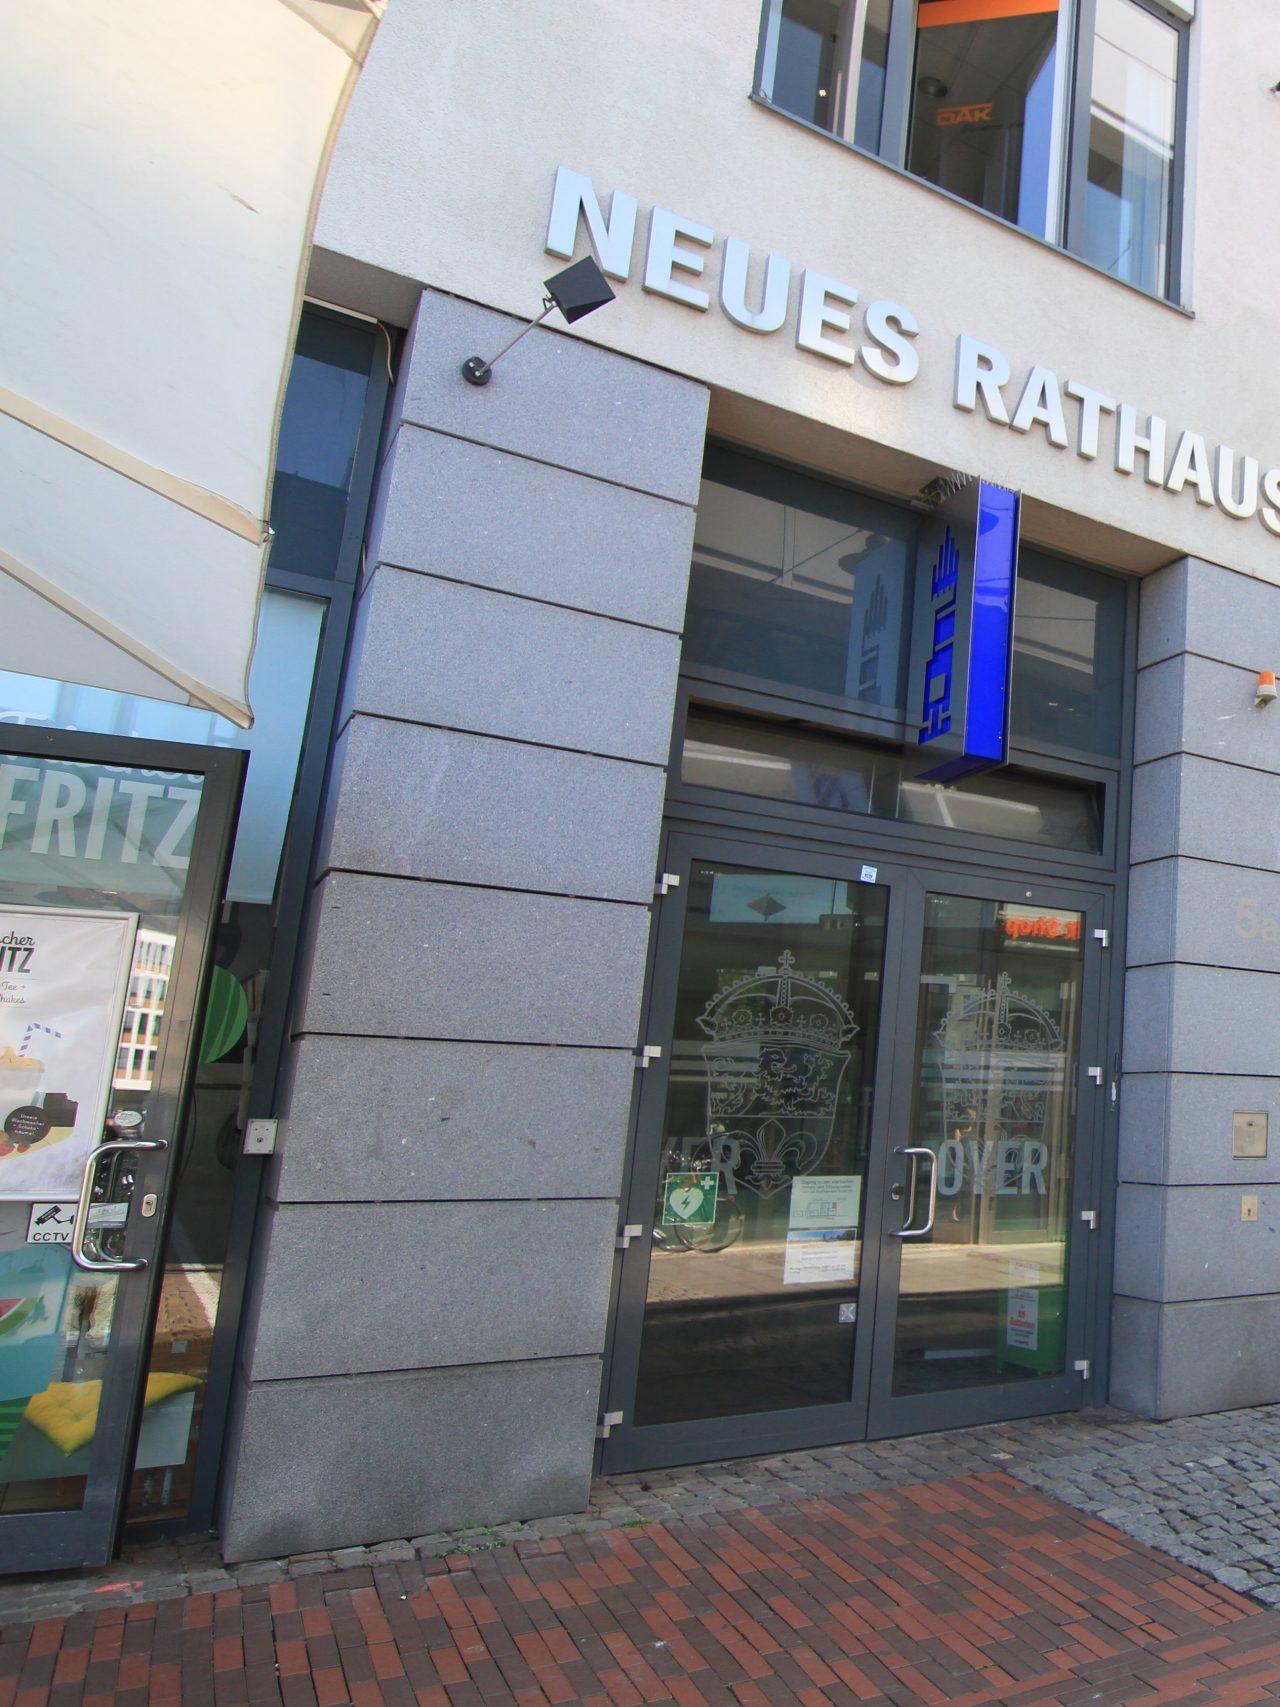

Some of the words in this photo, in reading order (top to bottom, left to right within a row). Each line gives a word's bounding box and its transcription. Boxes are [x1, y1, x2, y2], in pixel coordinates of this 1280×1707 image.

[936, 103, 992, 128] DAK
[545, 165, 920, 386] NEUES
[0, 764, 202, 870] FRITZ
[1231, 896, 1280, 942] 5a
[925, 1138, 1048, 1197] OYER
[32, 1232, 70, 1242] CCTV
